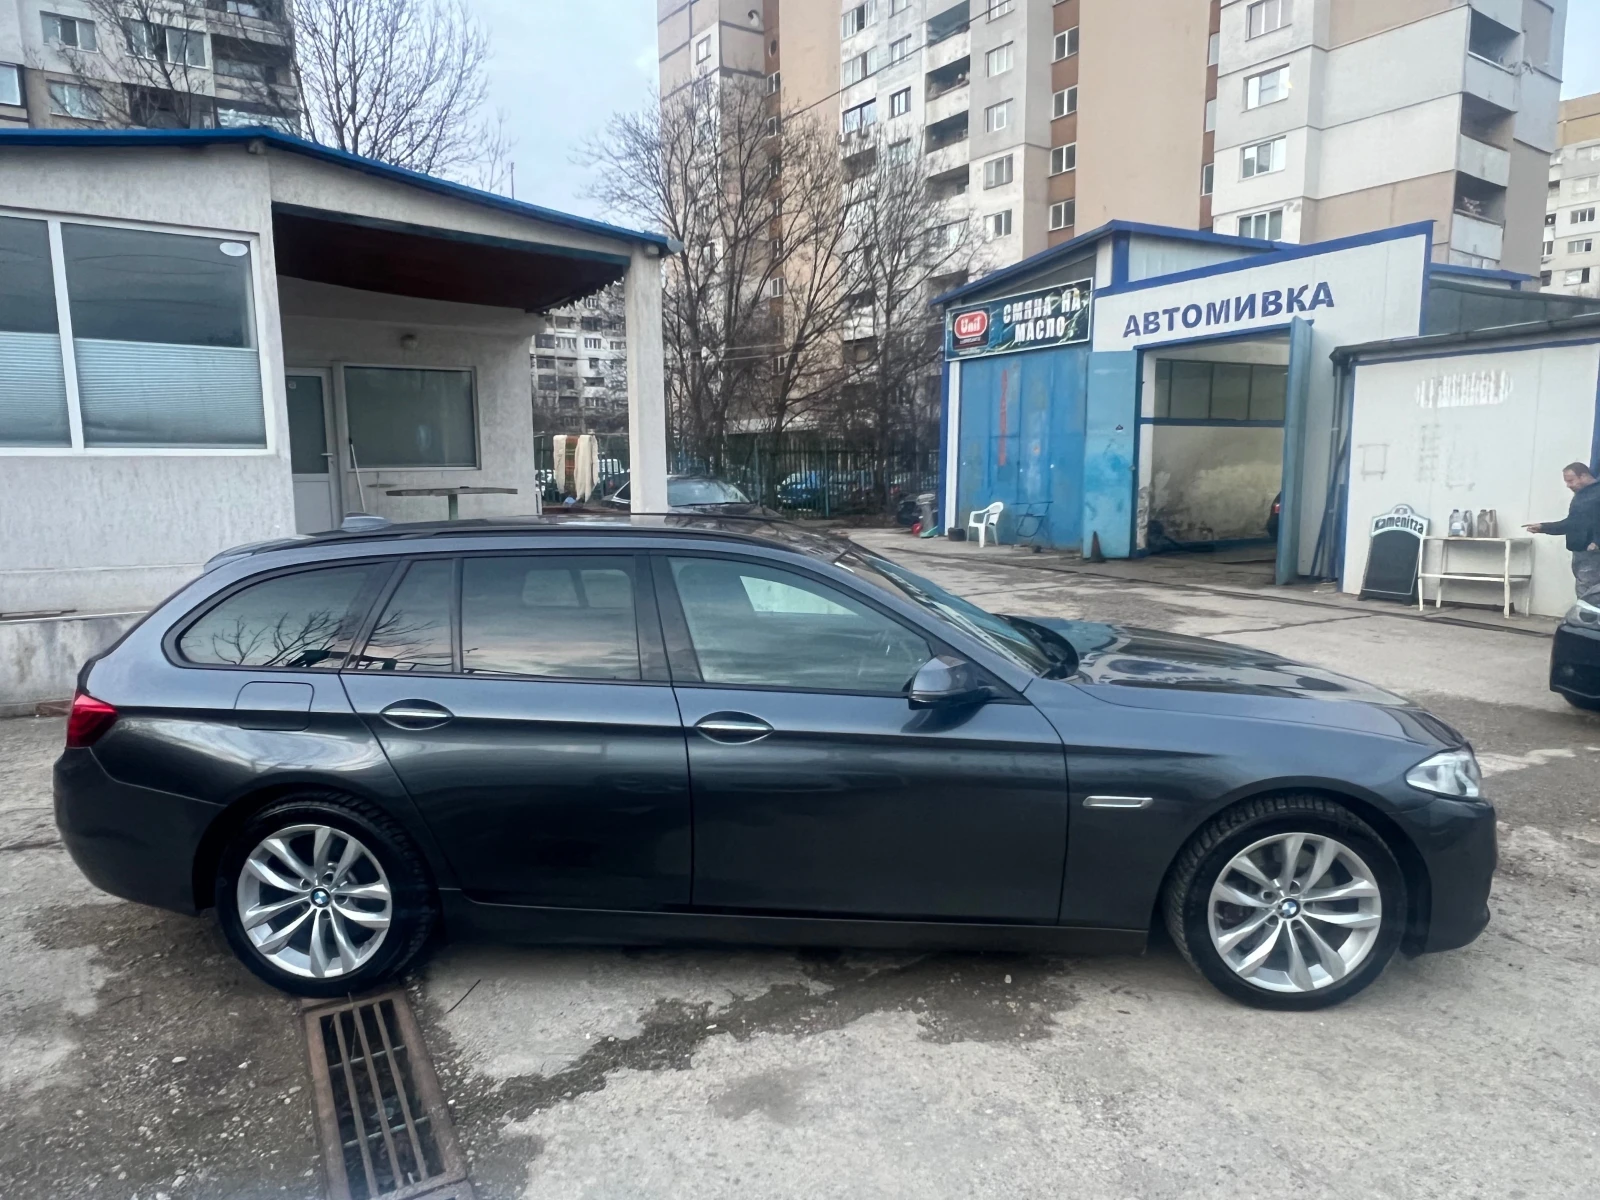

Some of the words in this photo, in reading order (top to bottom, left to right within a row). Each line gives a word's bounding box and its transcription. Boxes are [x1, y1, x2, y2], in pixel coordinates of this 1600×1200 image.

[1003, 296, 1052, 324] СМЯНА
[1061, 287, 1081, 313] НА
[1122, 281, 1335, 338] АВТОМИВКА
[1014, 316, 1066, 343] МАСЛО
